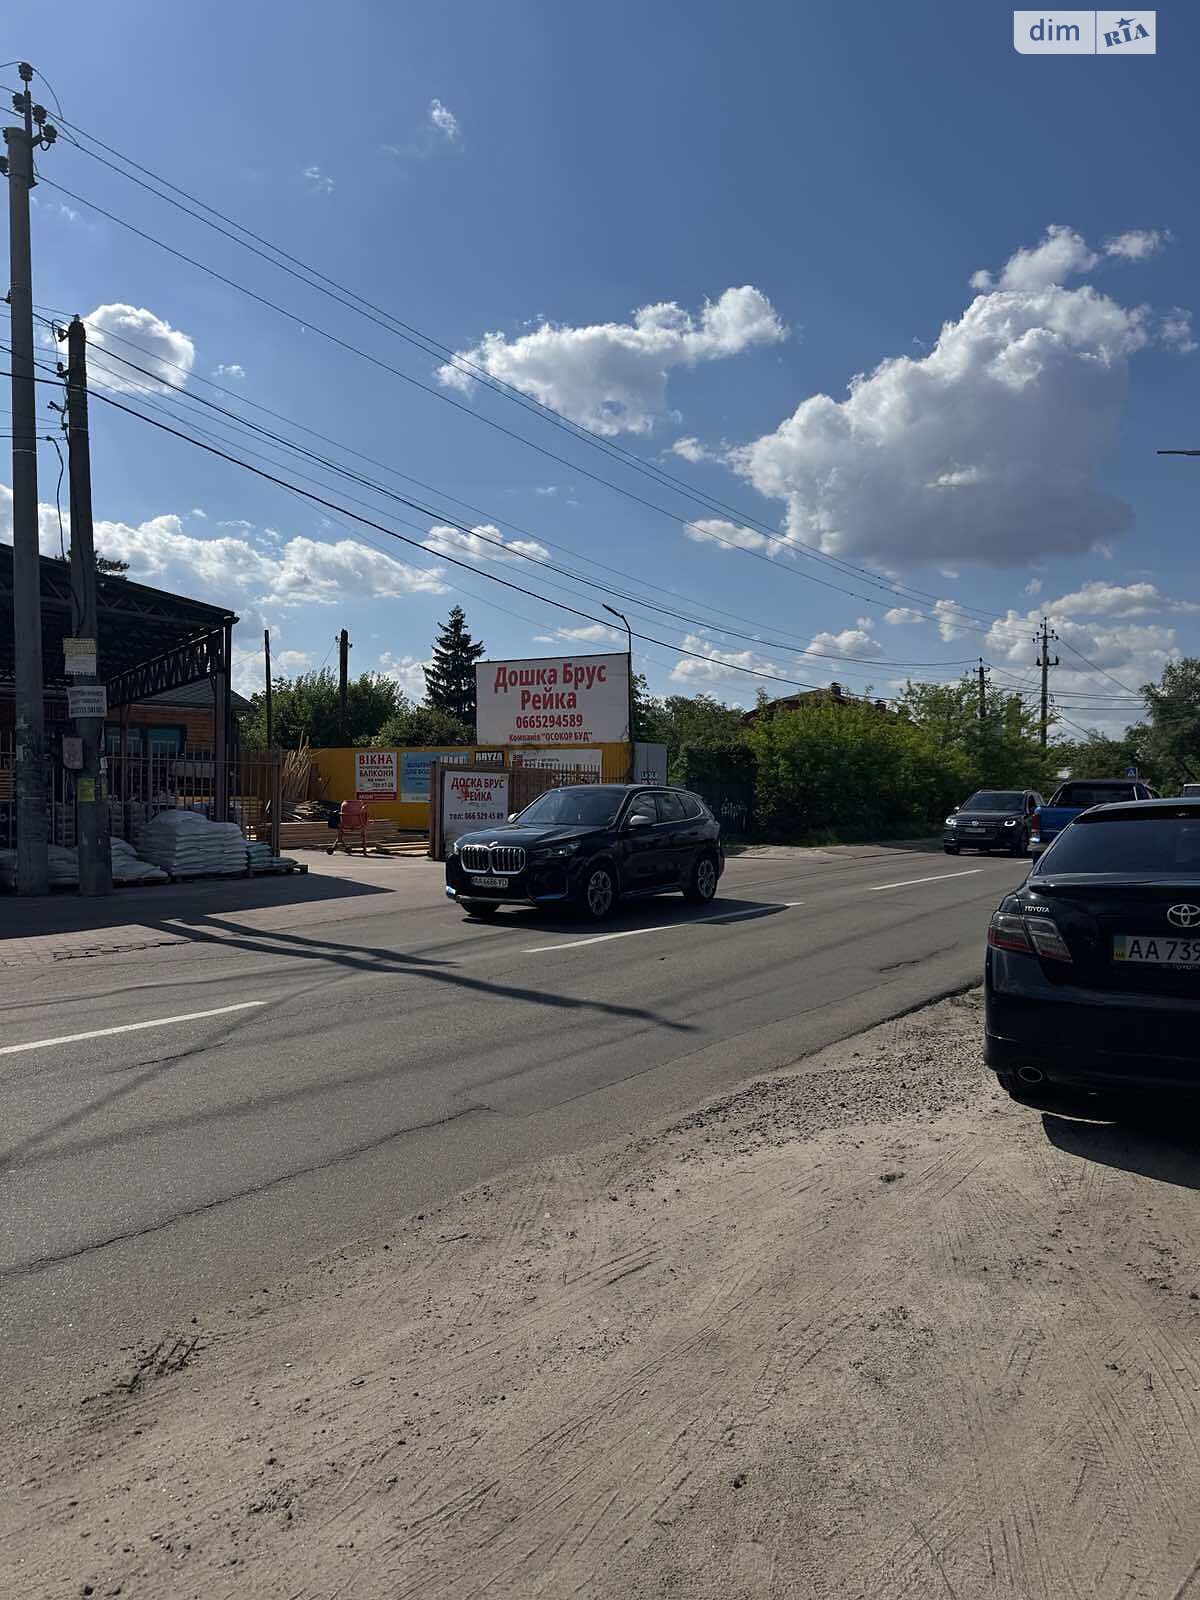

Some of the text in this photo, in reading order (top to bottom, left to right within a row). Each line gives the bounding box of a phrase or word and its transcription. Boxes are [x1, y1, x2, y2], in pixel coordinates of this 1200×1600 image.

[494, 663, 607, 693] Дошка Брус
[520, 687, 577, 711] Рейка
[516, 714, 583, 729] 0665294589
[359, 754, 393, 765] ВІКНА
[451, 777, 505, 790] ДОСКА БРУС
[463, 788, 492, 802] РЕЙКА
[1024, 905, 1050, 913] TOYOTA
[1129, 939, 1160, 960] AA
